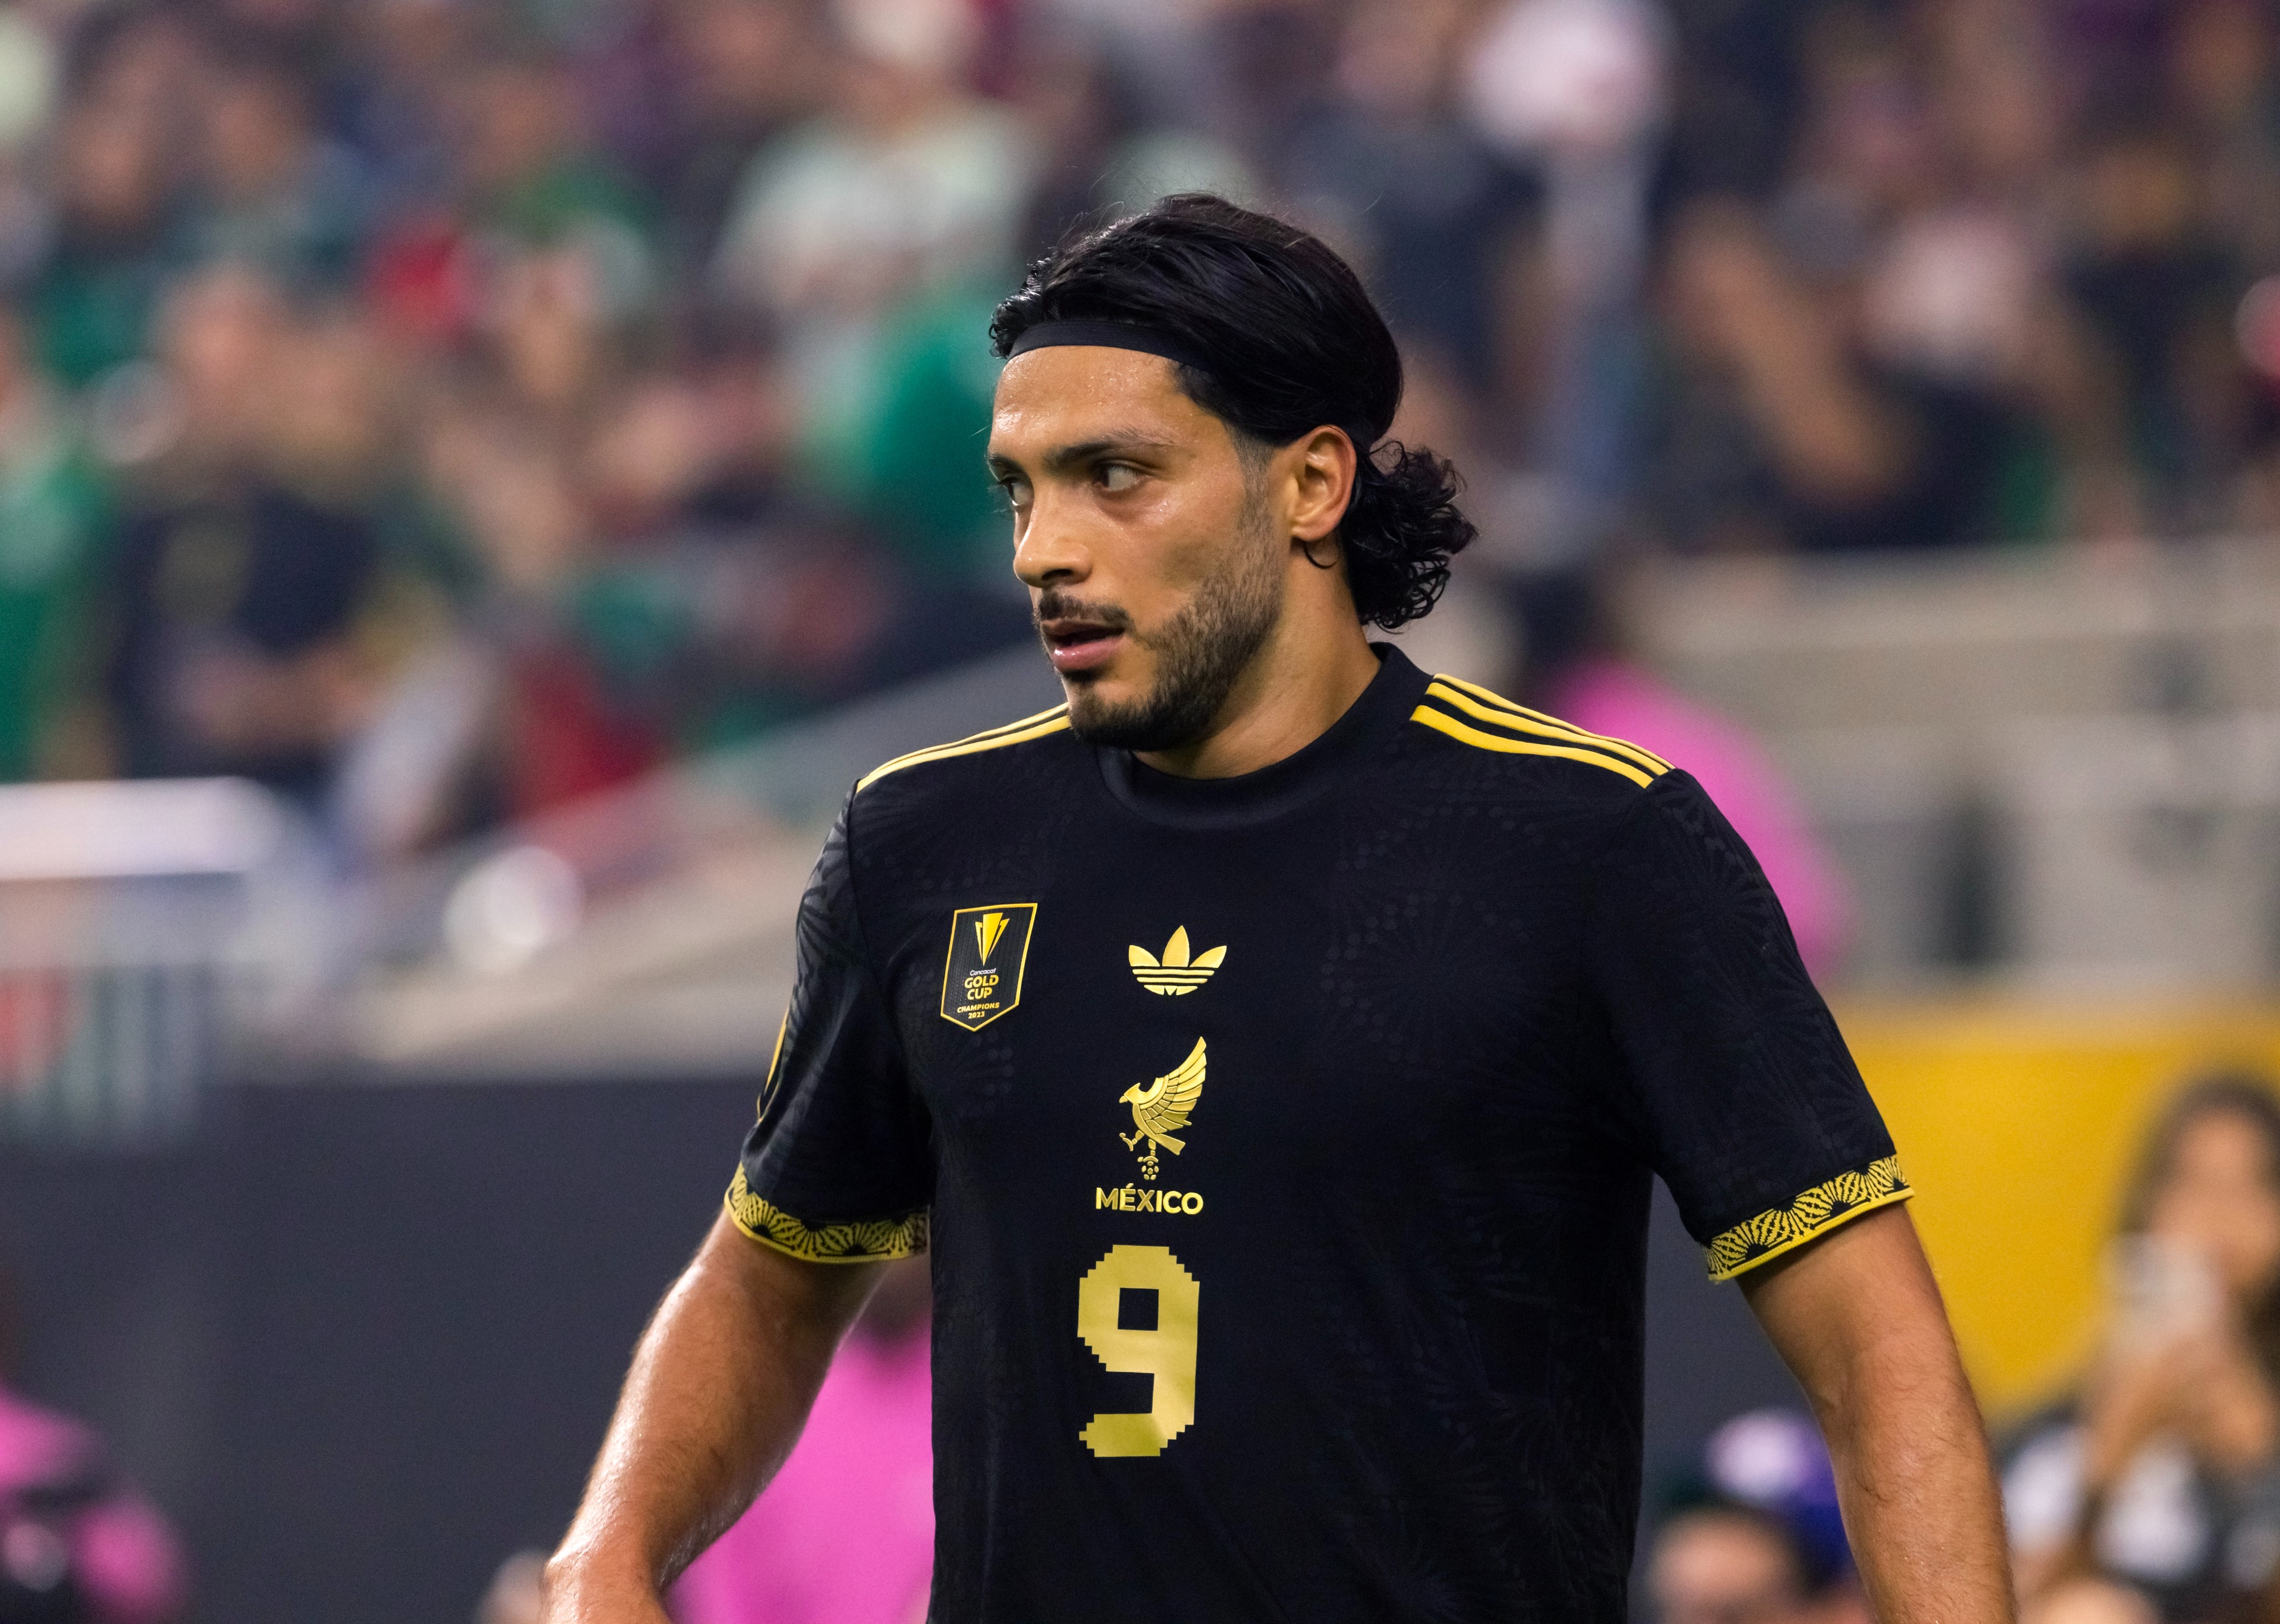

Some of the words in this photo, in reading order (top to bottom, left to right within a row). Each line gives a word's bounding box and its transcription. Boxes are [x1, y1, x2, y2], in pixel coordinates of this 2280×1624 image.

[970, 968, 996, 976] Concacaf
[964, 975, 999, 988] GOLD
[967, 987, 992, 1000] CUP
[957, 1002, 1000, 1013] CHAMPIONS
[1095, 1183, 1203, 1214] MÉXICO
[1077, 1244, 1200, 1457] 9
